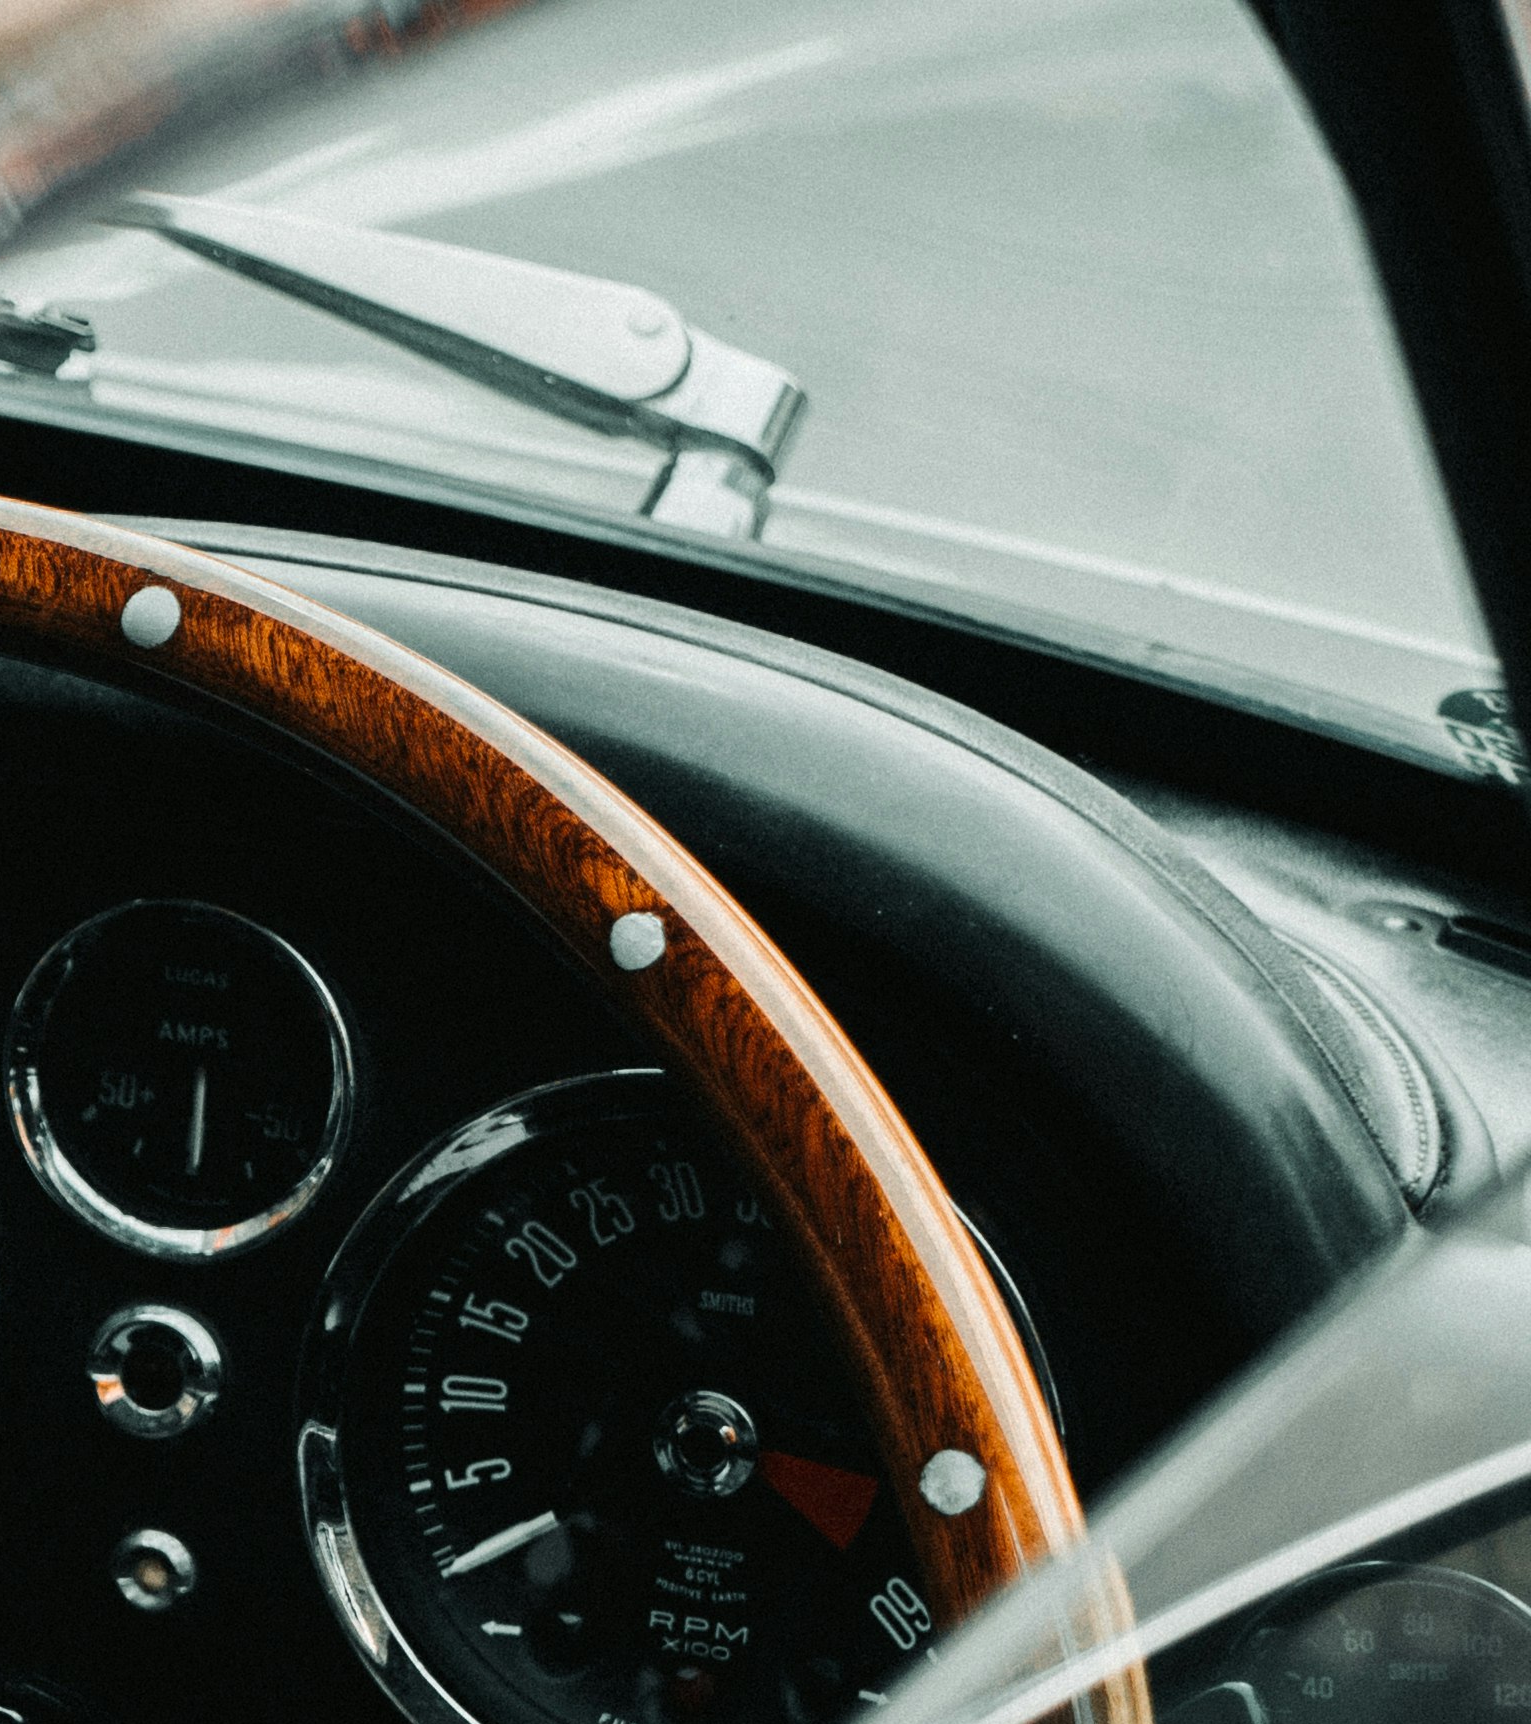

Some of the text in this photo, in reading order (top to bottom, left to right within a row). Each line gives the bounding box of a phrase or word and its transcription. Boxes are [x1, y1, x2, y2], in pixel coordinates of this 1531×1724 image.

[163, 965, 230, 990] LUCAS
[156, 1019, 231, 1050] AMPS
[646, 1160, 706, 1222] 30
[567, 1176, 636, 1249] 25
[503, 1219, 578, 1289] 20
[457, 1291, 530, 1344] 15
[698, 1289, 757, 1317] SMITHS
[438, 1373, 509, 1415] 10
[443, 1456, 513, 1492] 5
[655, 1575, 748, 1603] POSITIVE EARTH
[696, 1567, 722, 1587] CYL
[647, 1608, 750, 1646] RPM
[1401, 1612, 1434, 1637] 80
[660, 1635, 732, 1662] X100
[1343, 1628, 1375, 1654] 60
[1301, 1676, 1334, 1700] 40
